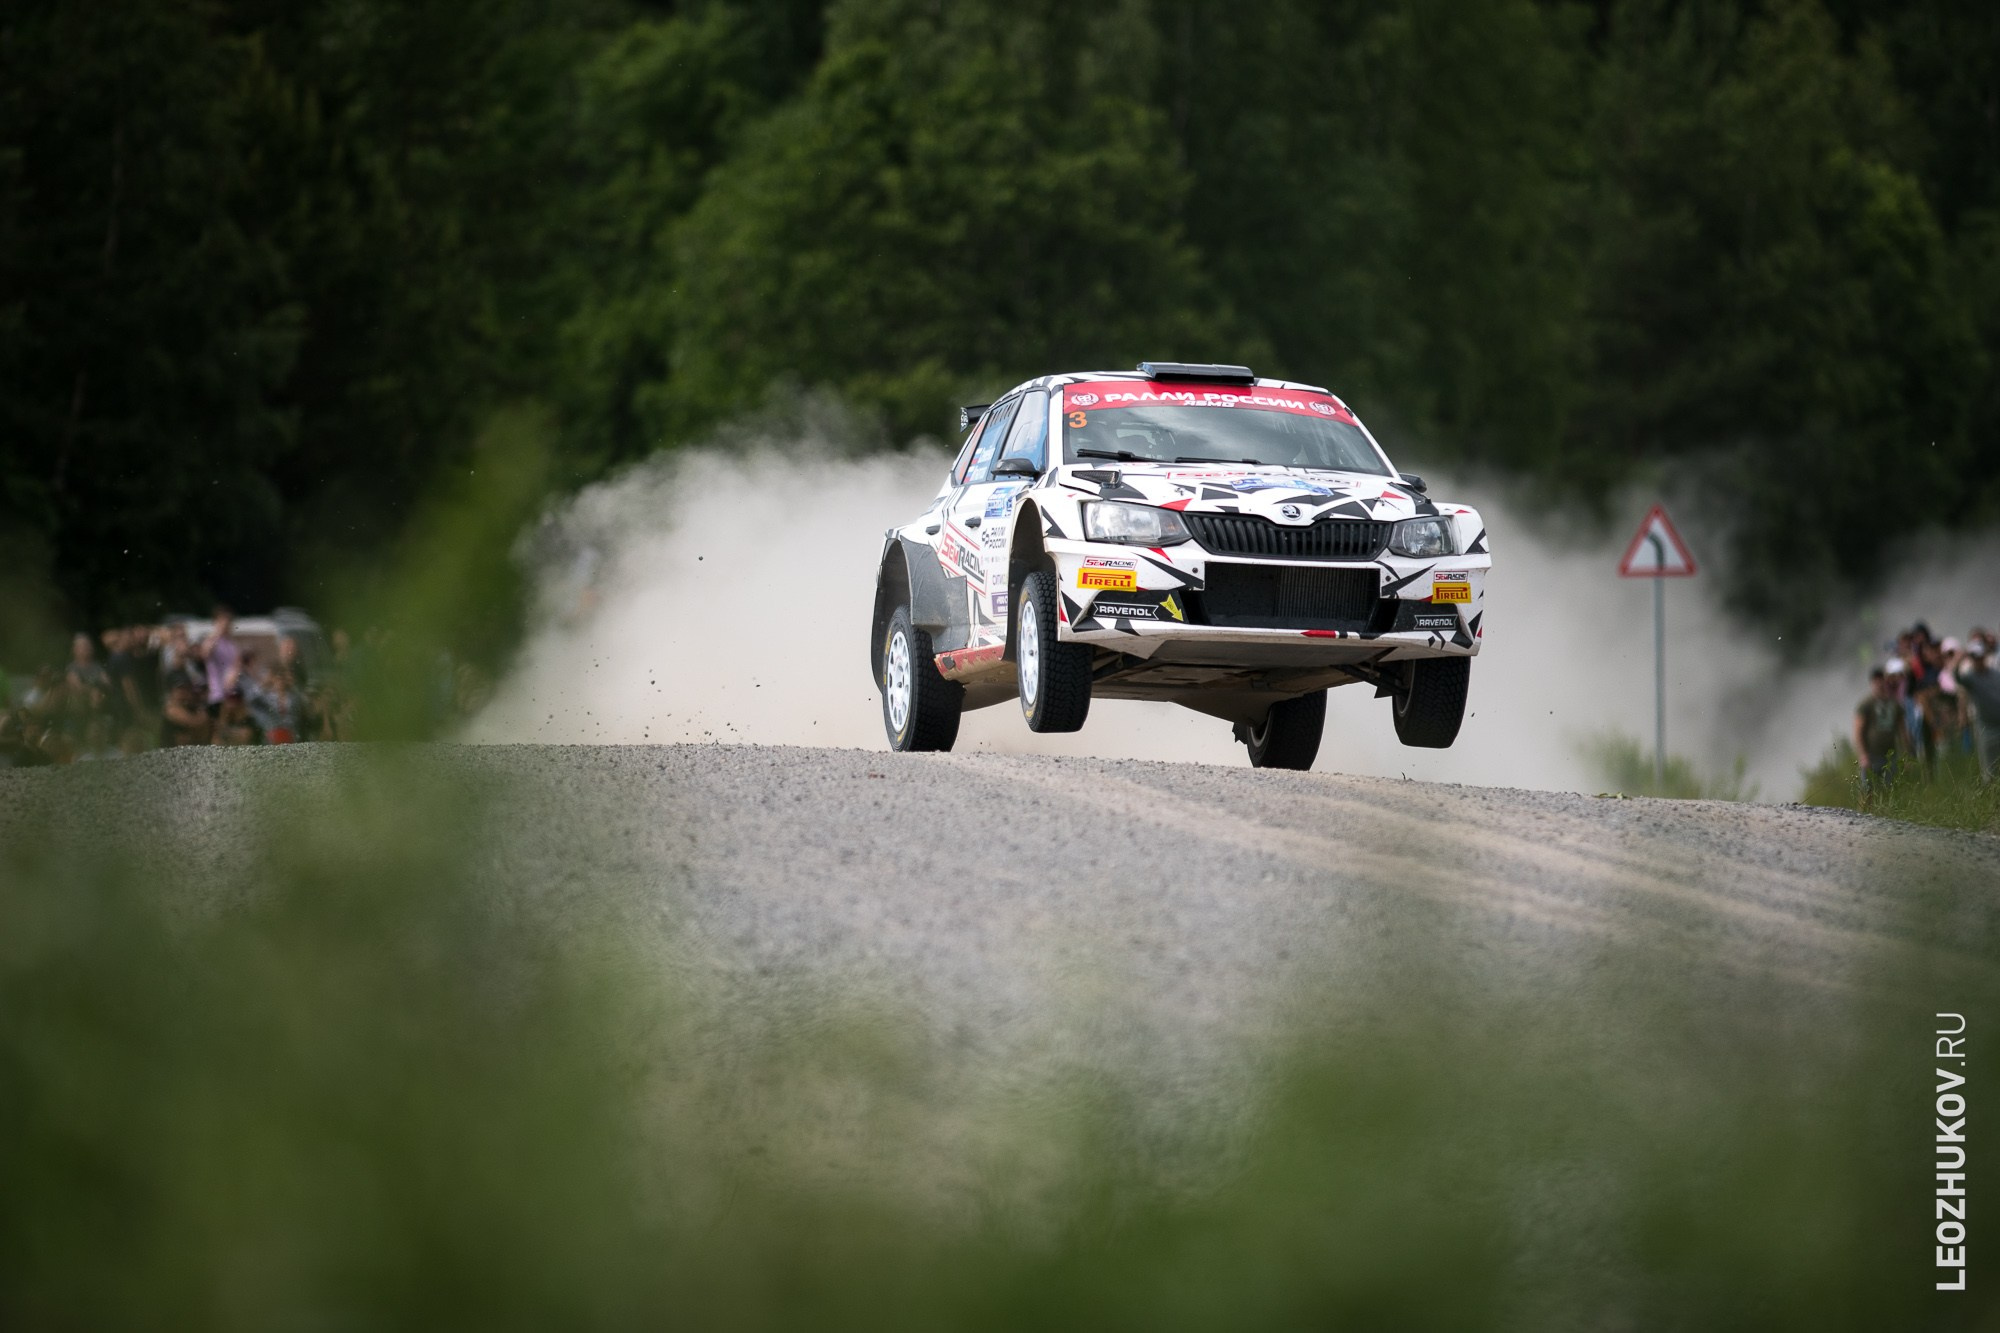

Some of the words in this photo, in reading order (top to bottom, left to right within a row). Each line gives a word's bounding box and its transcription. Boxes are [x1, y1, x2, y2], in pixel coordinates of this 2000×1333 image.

[1104, 392, 1196, 402] РАЛЛИ
[1202, 392, 1306, 410] РОССИИ
[1068, 411, 1088, 429] 3
[1081, 572, 1132, 587] PIRELLI
[1435, 587, 1468, 600] PIRELLI
[1099, 605, 1152, 617] RAVENOL
